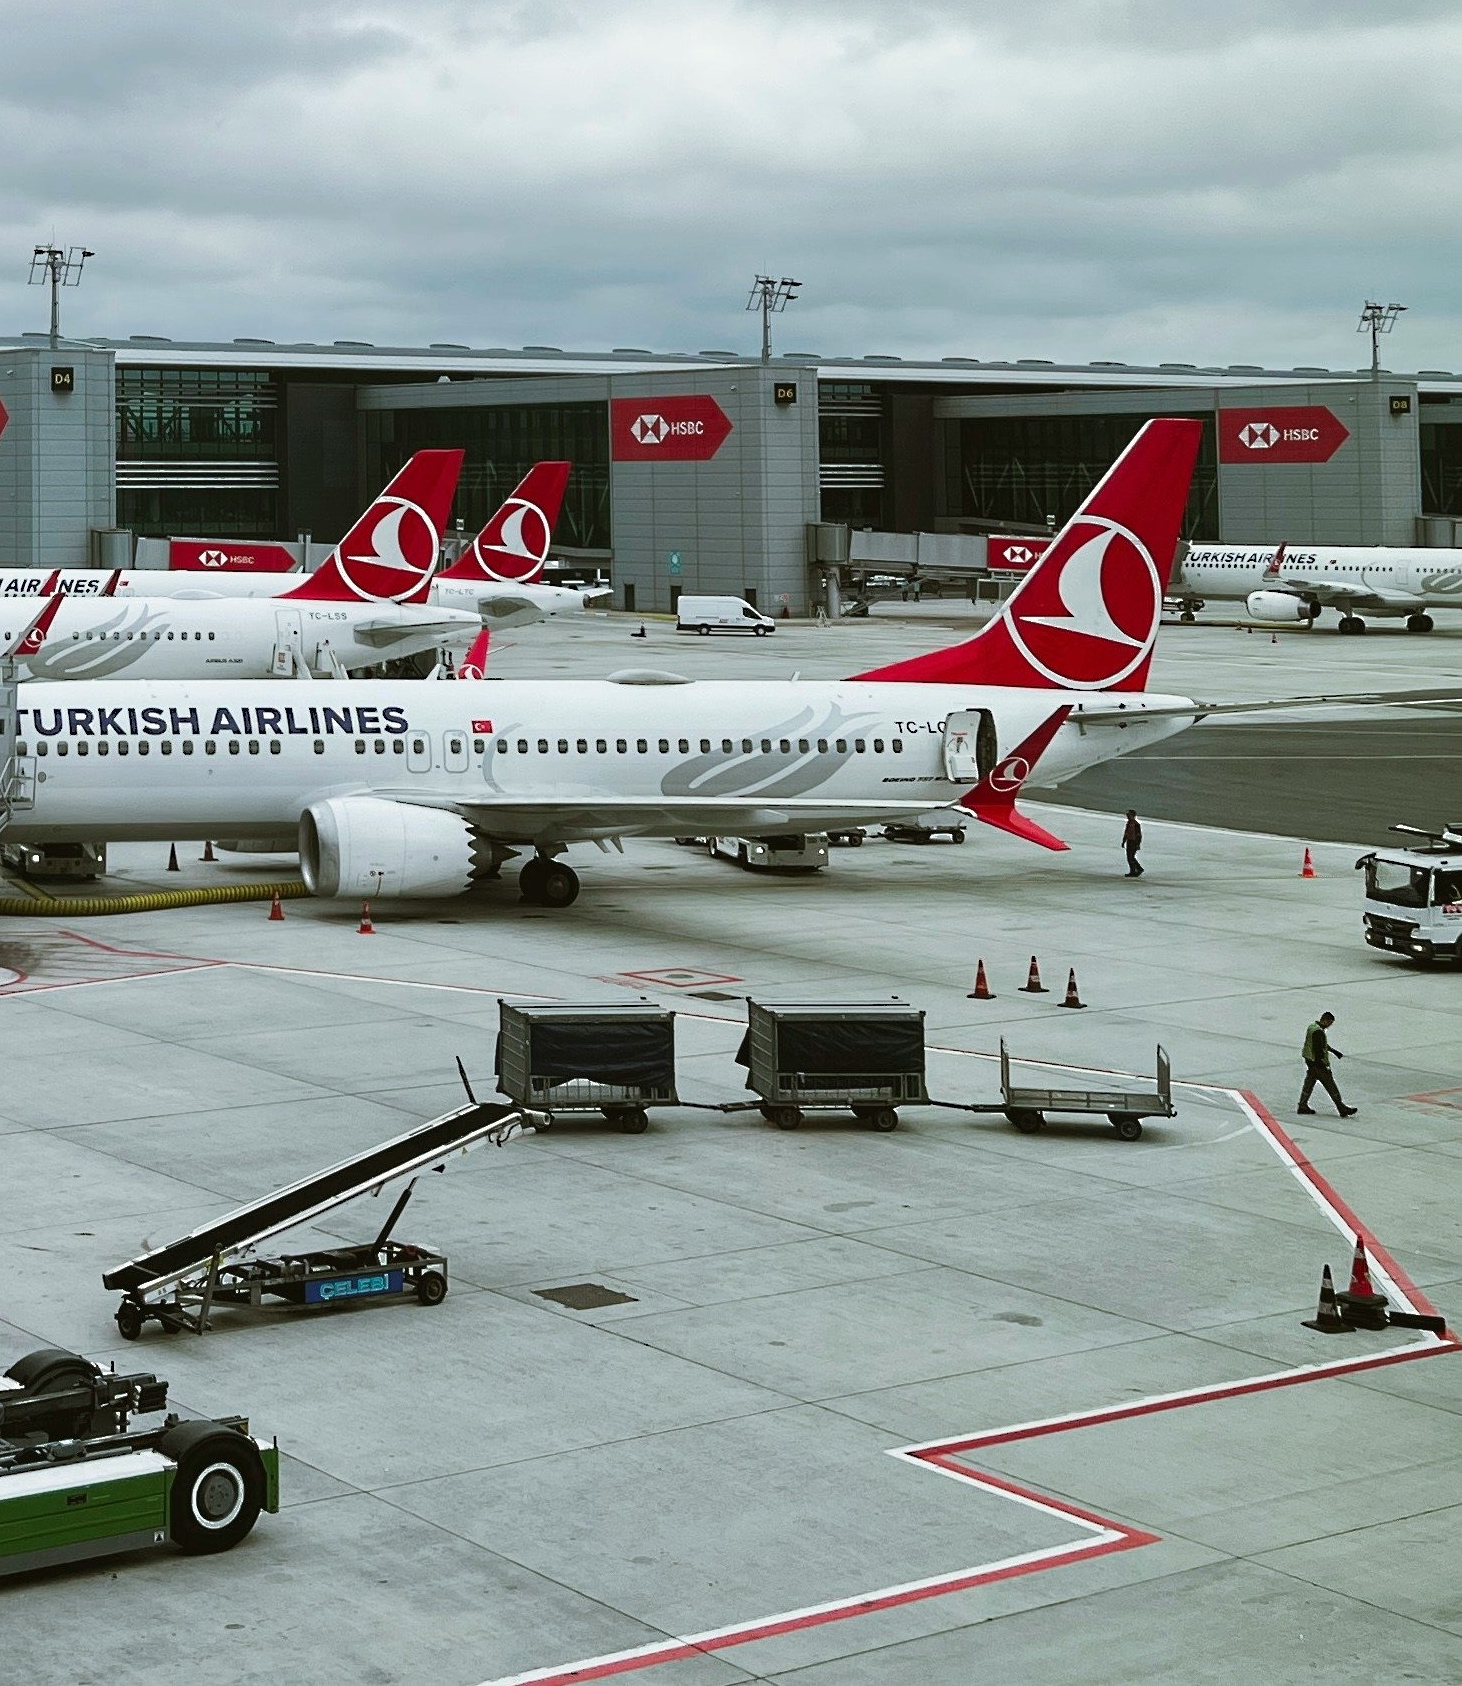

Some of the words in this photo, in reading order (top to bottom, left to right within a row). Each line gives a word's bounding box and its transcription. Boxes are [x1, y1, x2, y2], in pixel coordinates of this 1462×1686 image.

[55, 374, 71, 384] D4
[777, 388, 794, 398] D6
[1392, 400, 1408, 409] D8
[671, 421, 704, 435] HSBC
[1283, 428, 1319, 441] HSBC
[229, 556, 255, 565] HSBC
[1183, 551, 1246, 563] TURKISH
[1247, 553, 1317, 564] AIRNES
[5, 578, 99, 593] AIRNES
[16, 708, 200, 736] TURKISH
[210, 707, 409, 735] AIRLINES
